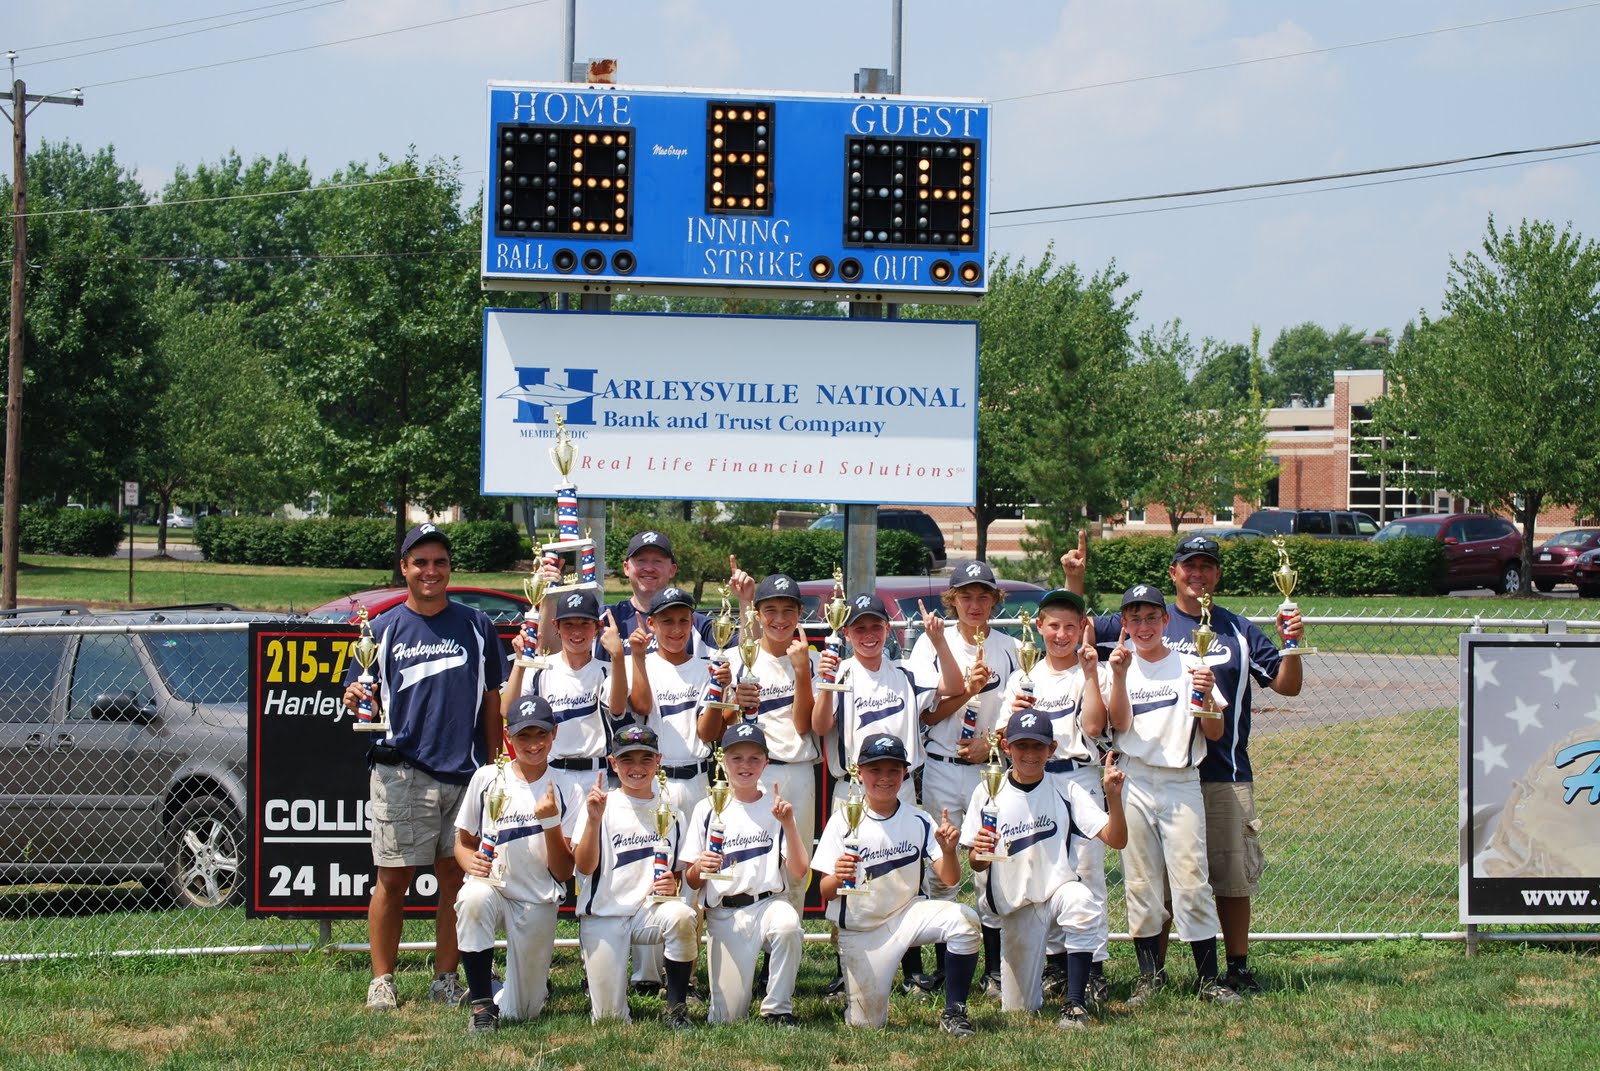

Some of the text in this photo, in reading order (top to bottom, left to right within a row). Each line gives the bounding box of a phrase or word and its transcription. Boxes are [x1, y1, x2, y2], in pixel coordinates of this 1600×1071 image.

[512, 91, 632, 125] HOME
[851, 103, 979, 137] GUEST
[572, 133, 628, 233] 5
[918, 145, 972, 244] 4
[687, 216, 791, 246] INNING
[497, 243, 549, 270] BALL
[703, 248, 804, 279] STRIKE
[873, 254, 924, 281] OUT
[815, 384, 966, 408] NATIONAL
[603, 410, 887, 438] Bank and Trust Company
[581, 455, 632, 470] Real
[648, 456, 693, 472] Life
[708, 458, 824, 475] Financial
[839, 461, 955, 478] Solutions
[393, 639, 460, 661] Harleysville
[547, 692, 597, 707] Harleysville
[657, 686, 700, 704] arleysville
[1130, 685, 1173, 701] arleysville
[1000, 815, 1051, 836] Harleysville
[612, 831, 661, 848] Harleysvil
[269, 864, 316, 896] 24
[1521, 889, 1600, 906] www.
